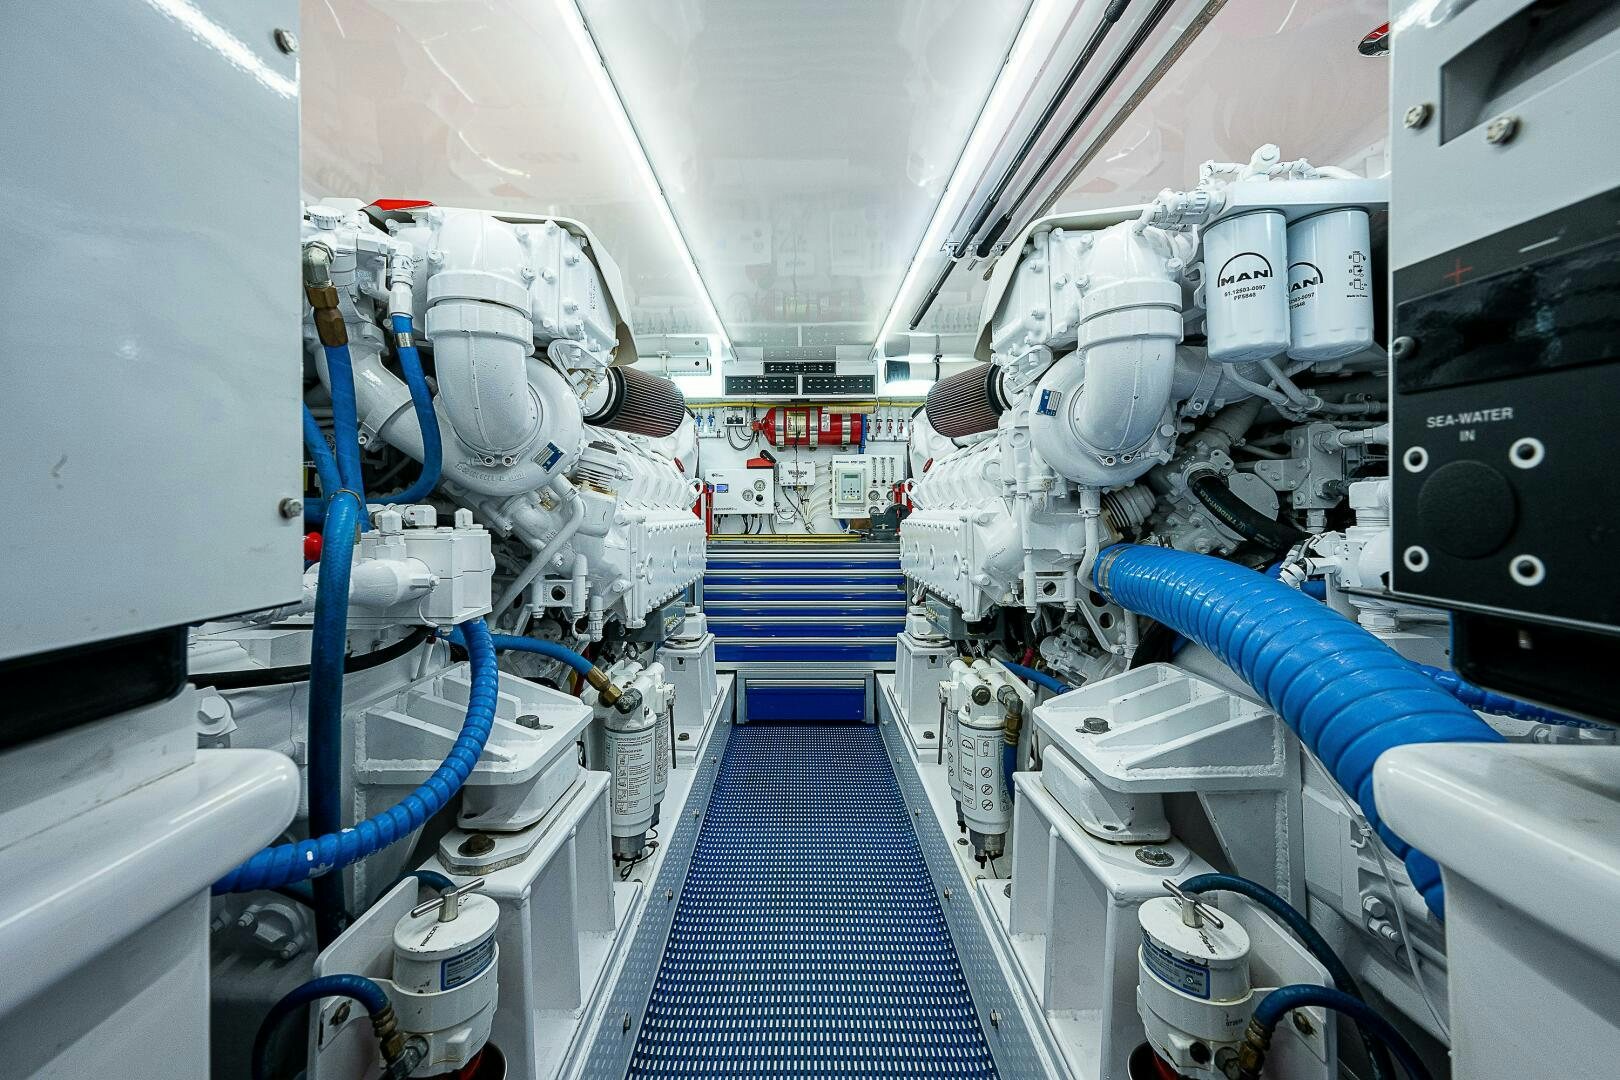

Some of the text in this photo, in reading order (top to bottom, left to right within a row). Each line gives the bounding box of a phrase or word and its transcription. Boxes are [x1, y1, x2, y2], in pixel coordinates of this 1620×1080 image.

[1220, 269, 1269, 287] MAN
[1426, 407, 1514, 429] SEA-WATER
[1460, 430, 1476, 442] IN
